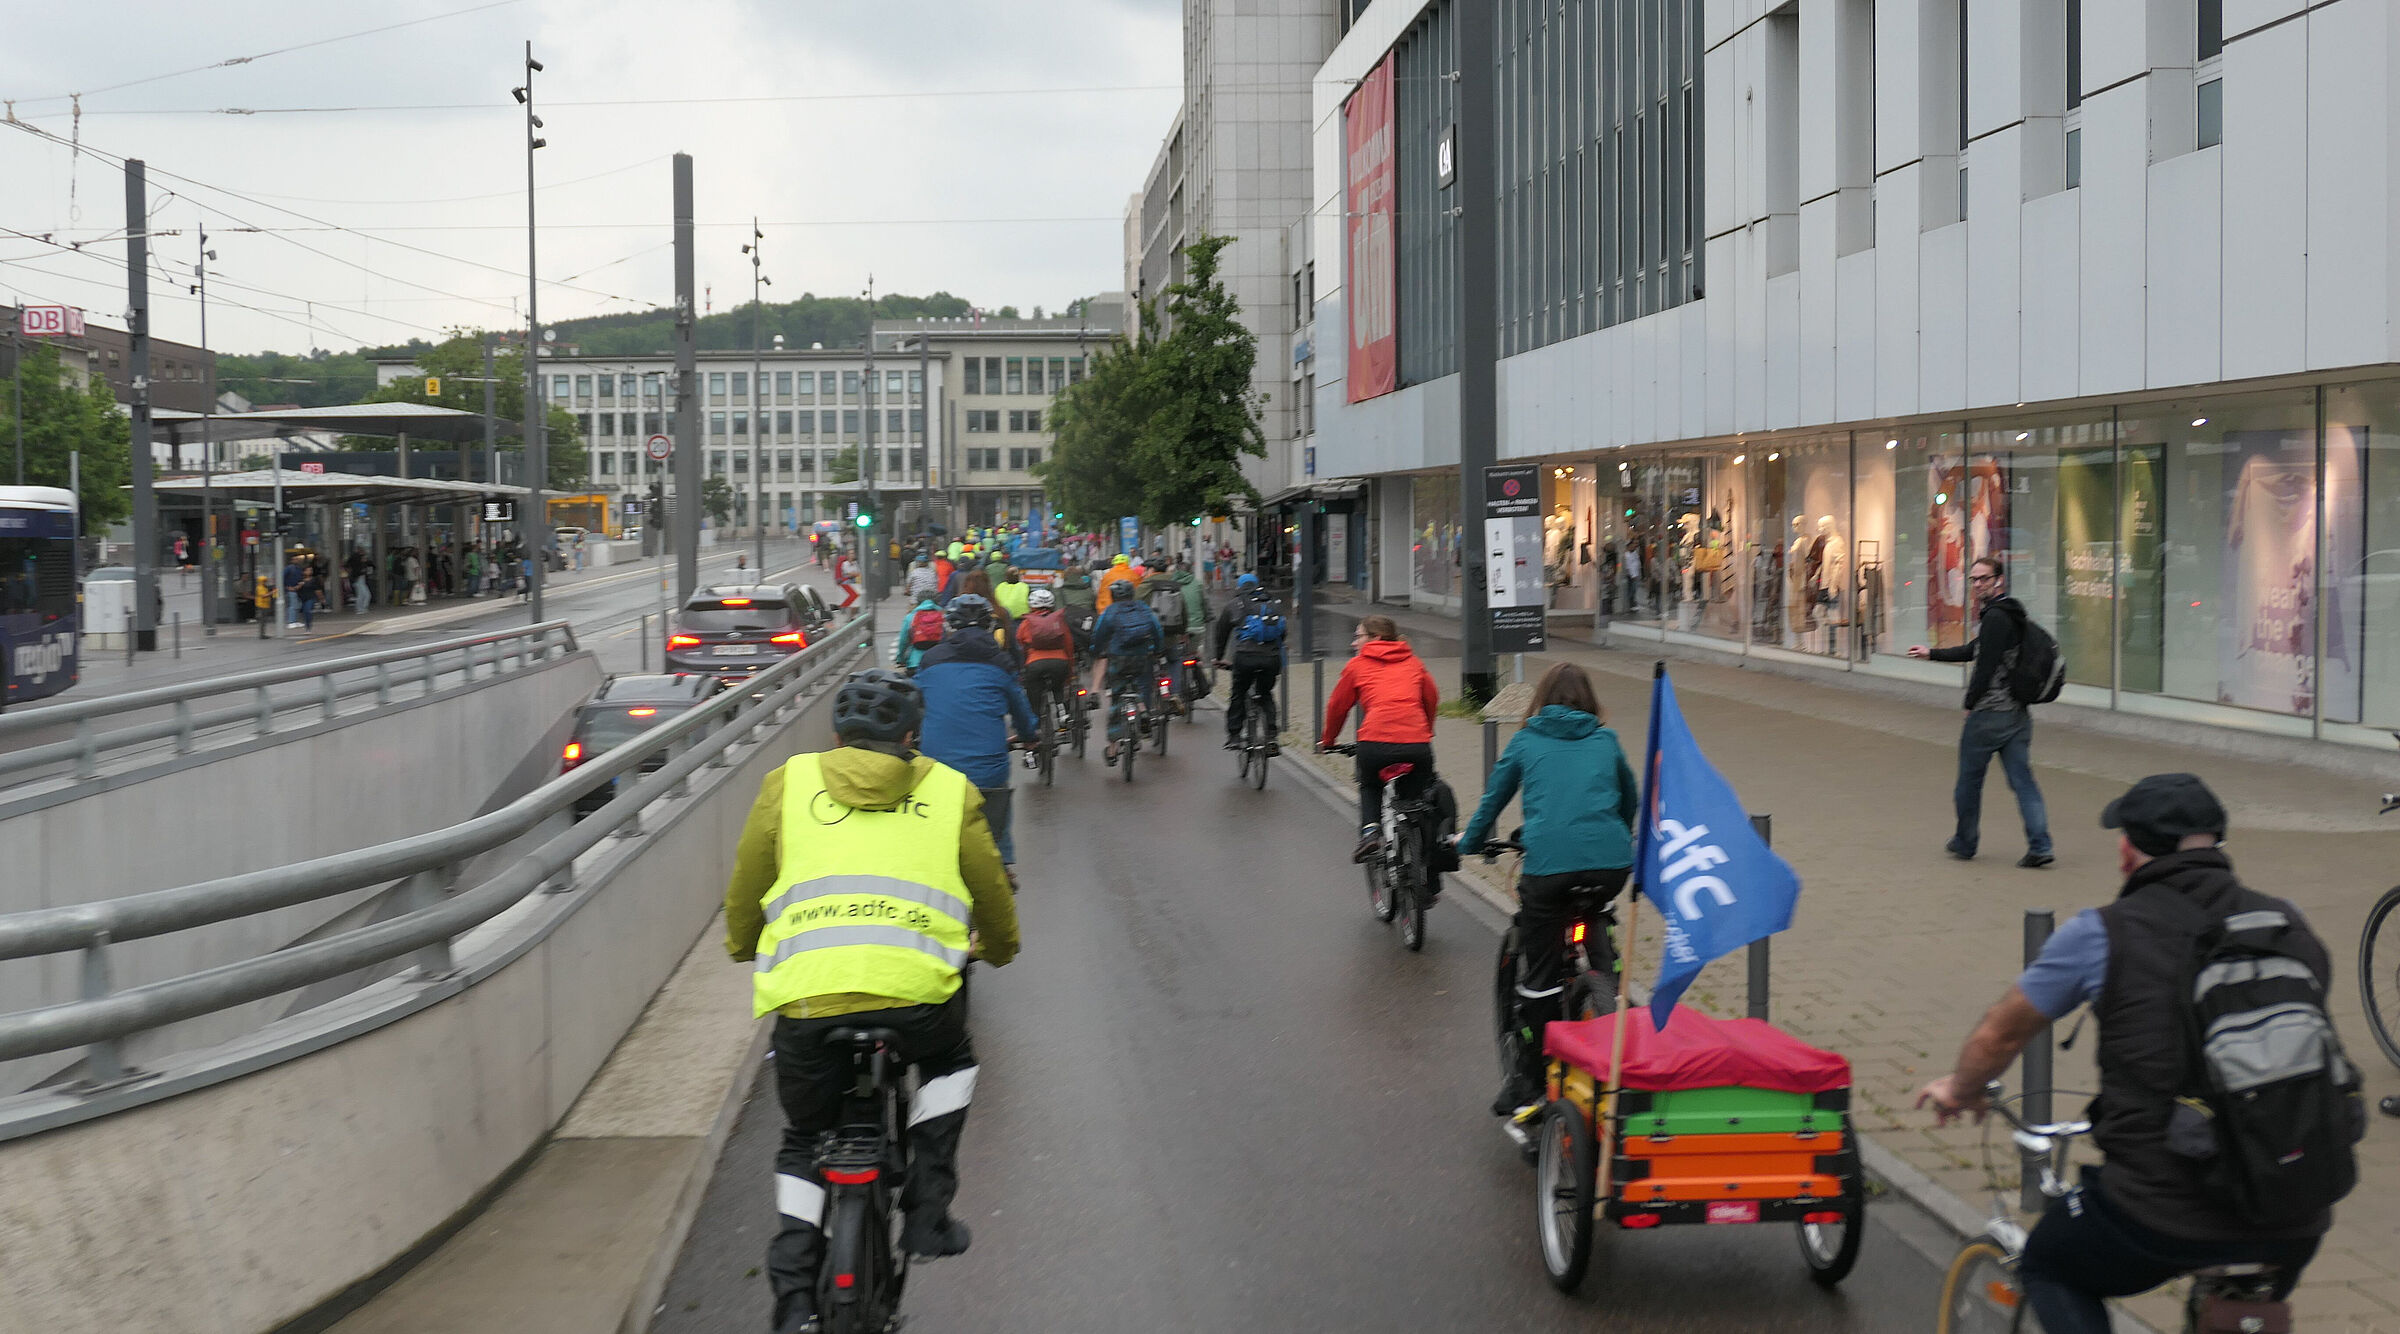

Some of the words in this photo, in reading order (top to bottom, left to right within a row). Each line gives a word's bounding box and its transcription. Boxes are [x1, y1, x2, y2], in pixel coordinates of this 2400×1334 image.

[28, 311, 59, 329] DB
[1652, 800, 1738, 921] dfc
[789, 899, 931, 928] www.adfc.de
